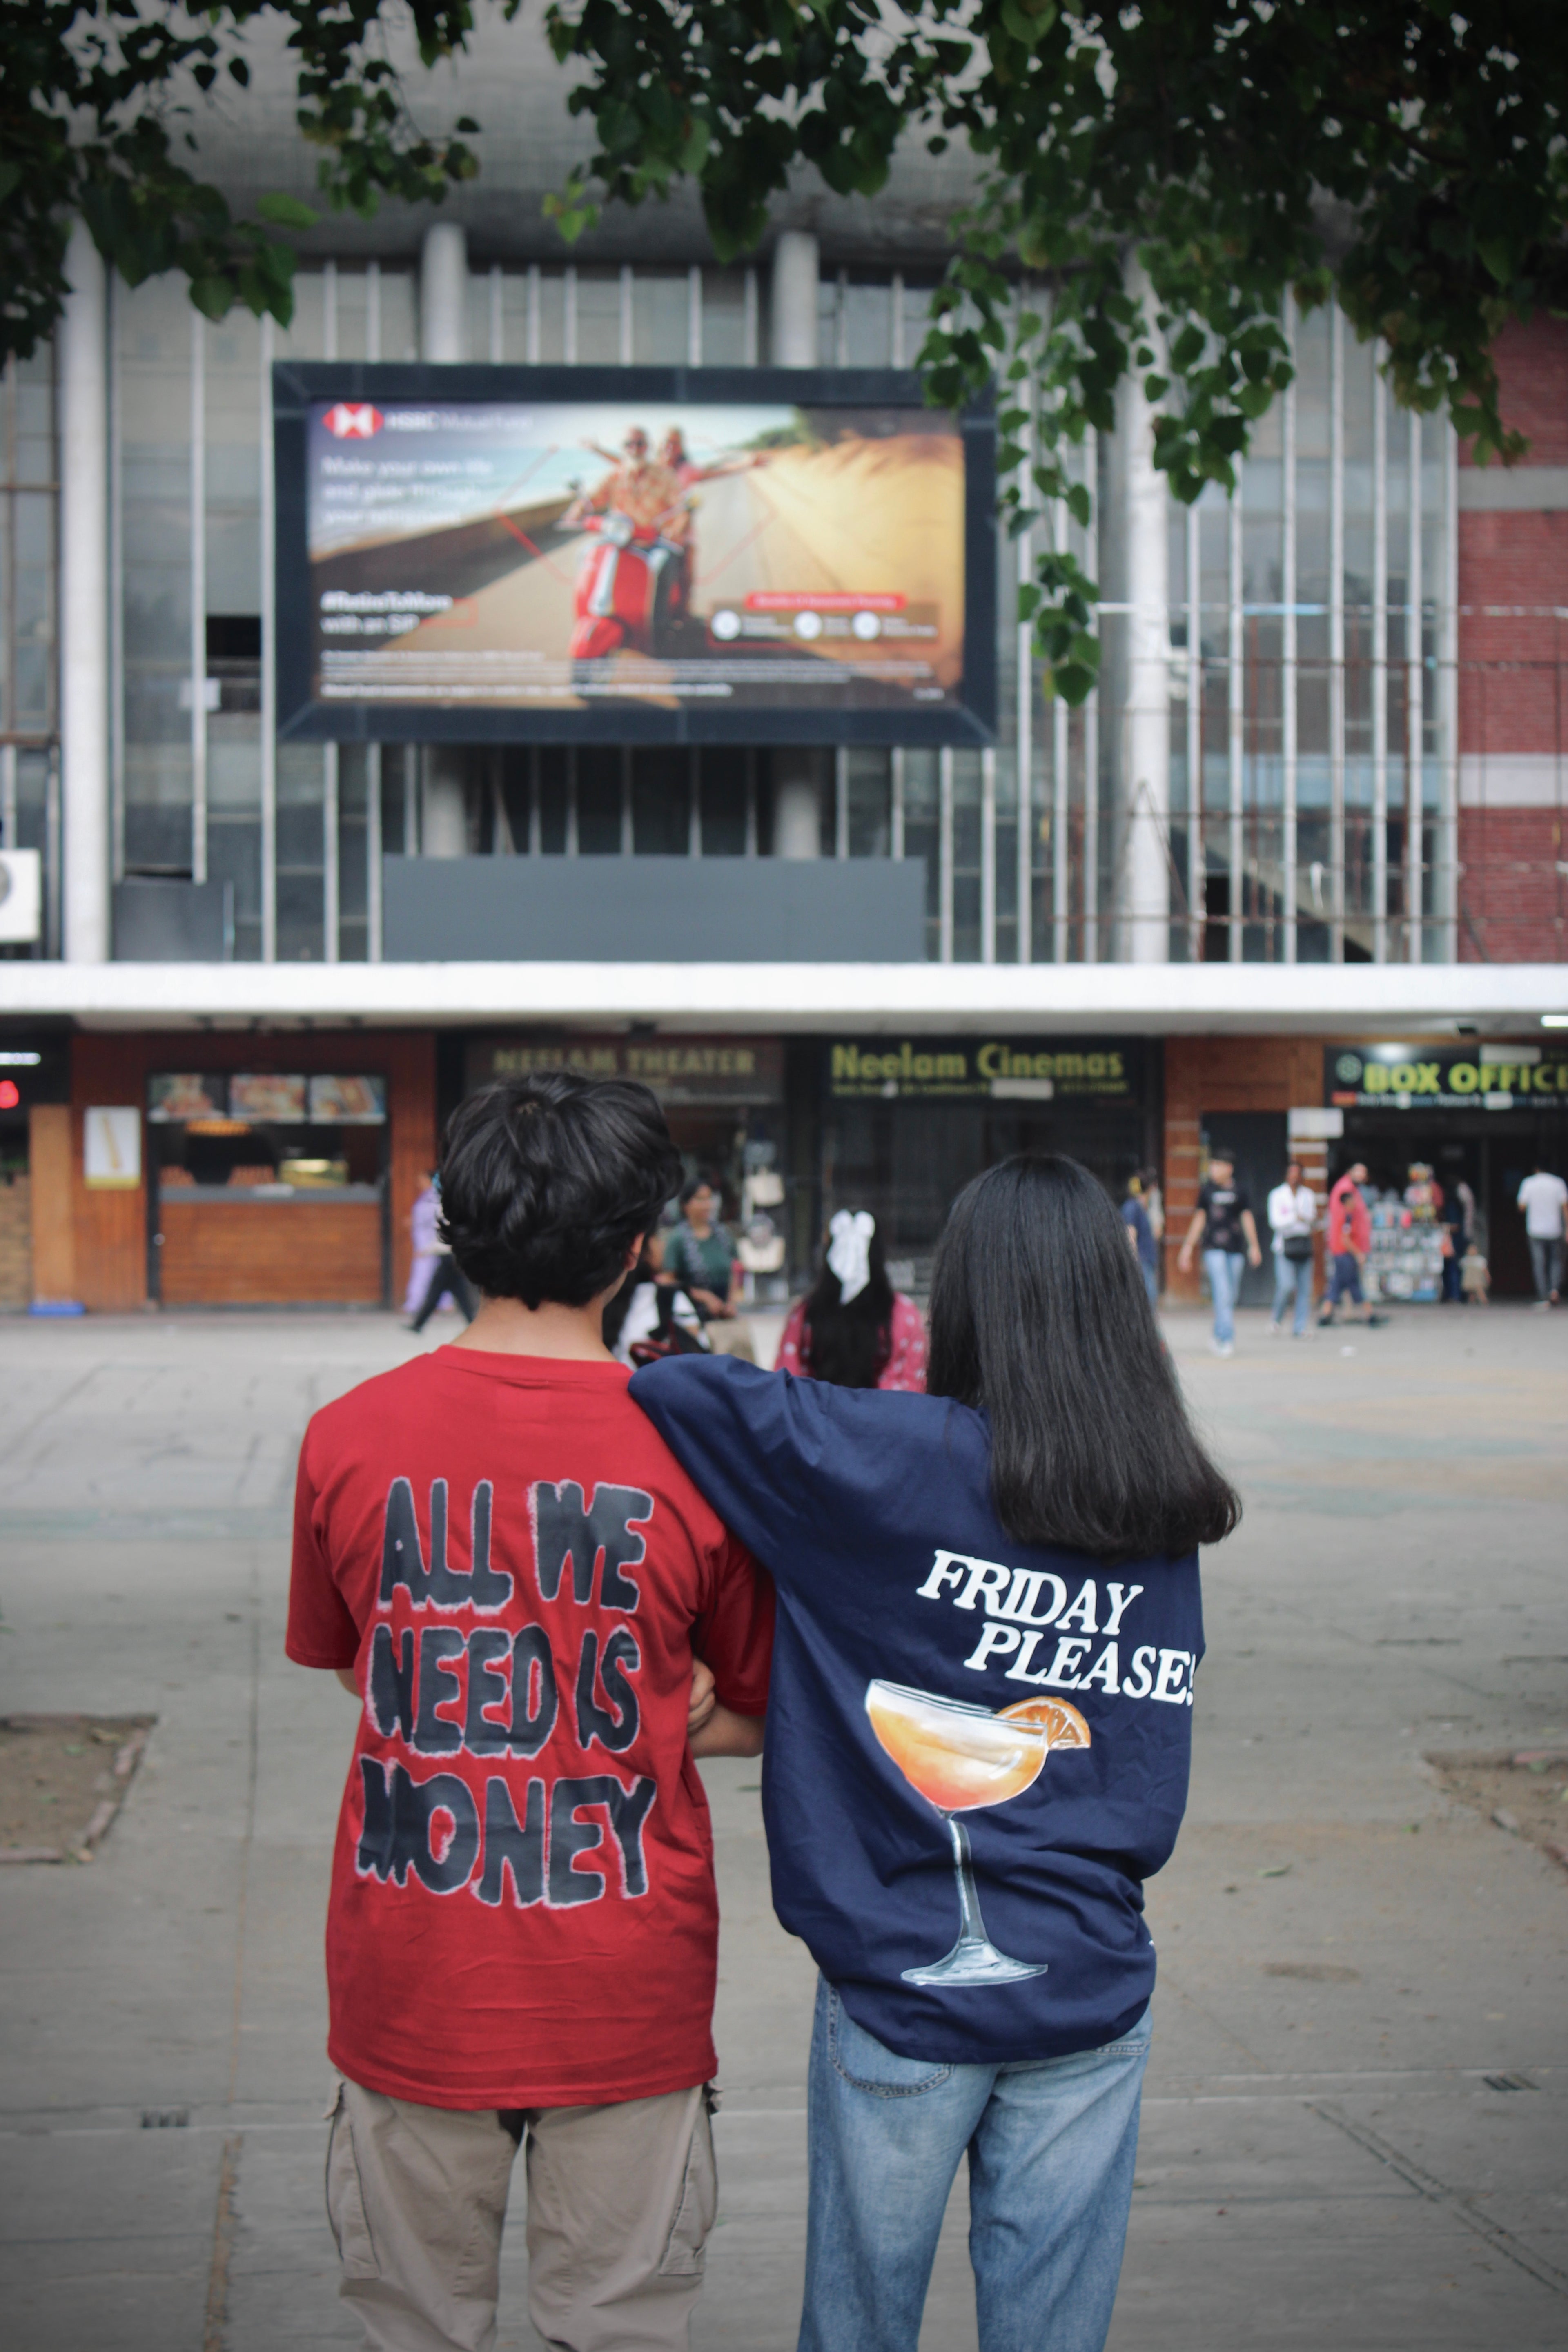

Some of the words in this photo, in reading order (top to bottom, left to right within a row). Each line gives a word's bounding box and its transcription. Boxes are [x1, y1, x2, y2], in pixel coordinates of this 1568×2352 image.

[831, 1042, 967, 1079] Neelam
[977, 1042, 1125, 1079] Cinemas
[1364, 1062, 1441, 1093] BOX
[376, 1476, 514, 1615] ALL
[916, 1549, 1144, 1636] FRIDAY
[365, 1622, 559, 1759] NEED
[574, 1624, 641, 1753] IS
[963, 1621, 1197, 1706] PLEASE!
[355, 1753, 657, 1910] MONEY
